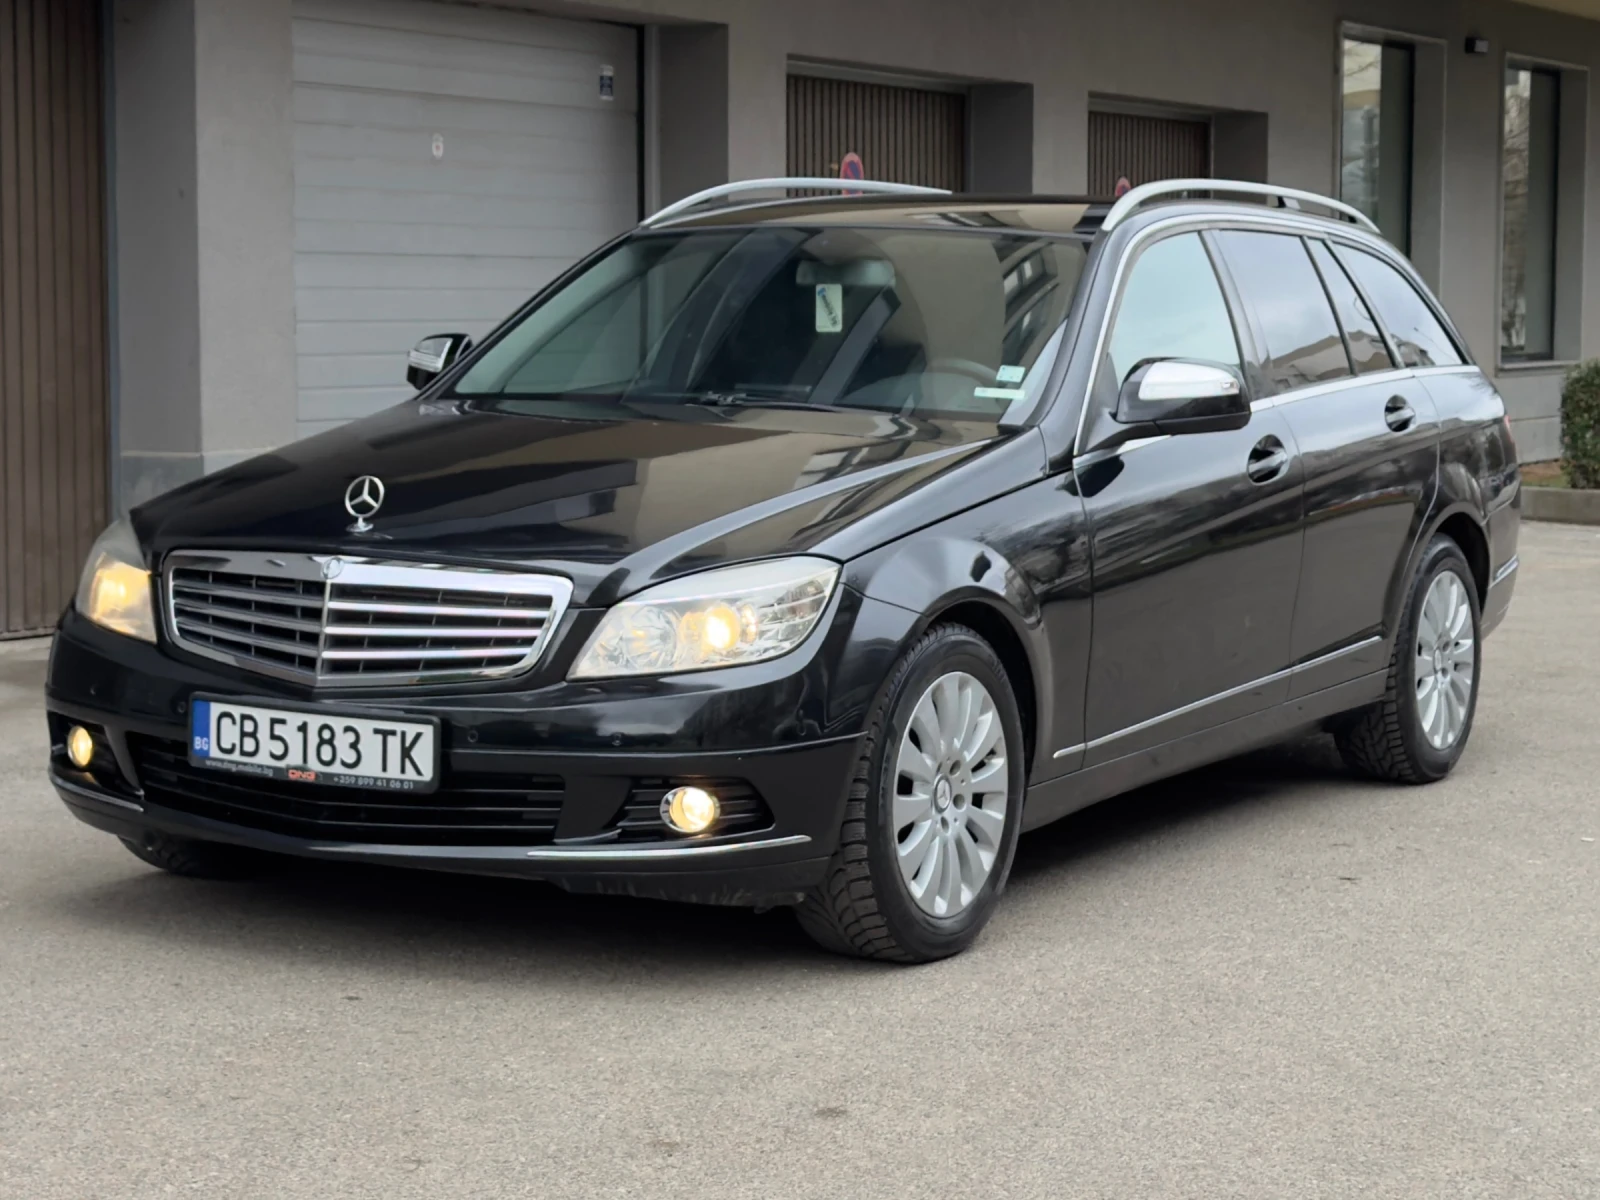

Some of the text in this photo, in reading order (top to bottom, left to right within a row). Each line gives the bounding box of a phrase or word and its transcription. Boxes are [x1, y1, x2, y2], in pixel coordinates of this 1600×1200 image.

[194, 735, 209, 751] BG
[217, 710, 424, 777] CB 5183 TK
[357, 777, 375, 787] 899
[403, 781, 414, 790] 01
